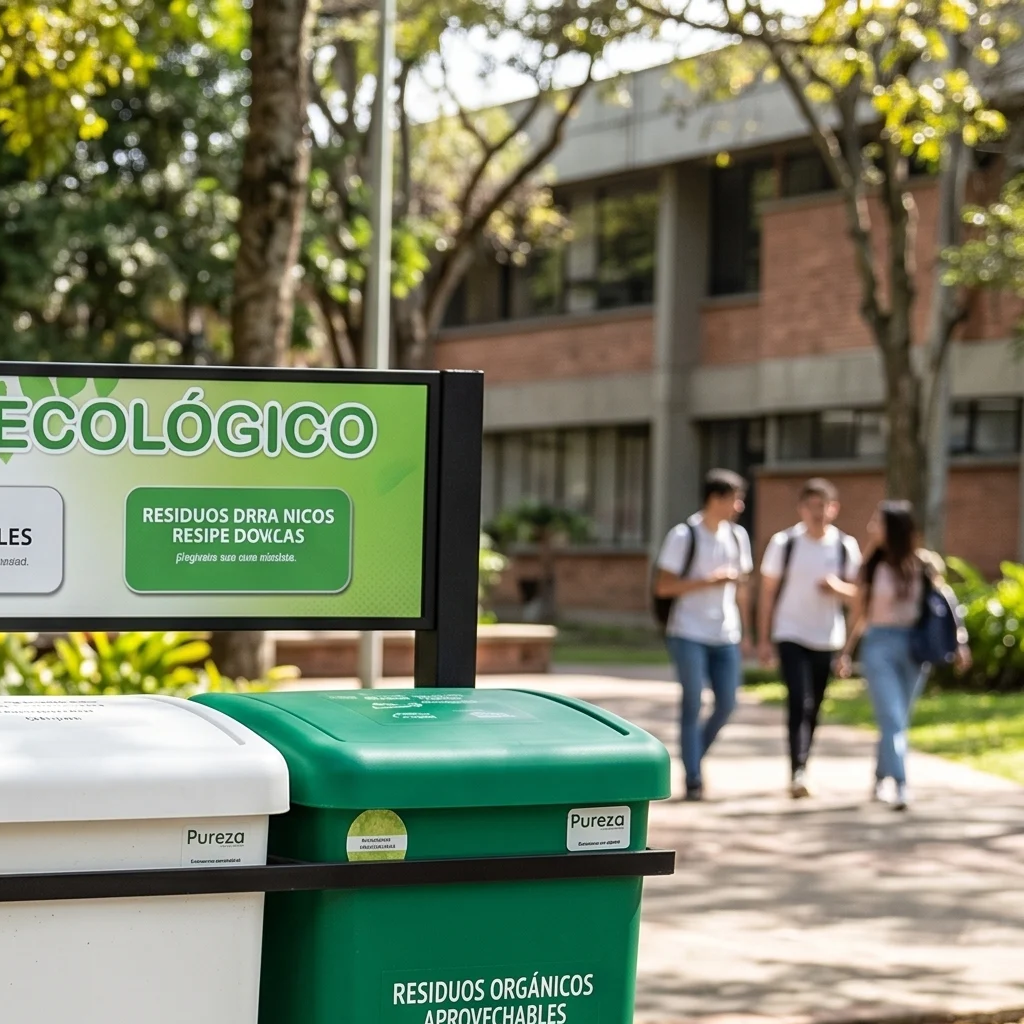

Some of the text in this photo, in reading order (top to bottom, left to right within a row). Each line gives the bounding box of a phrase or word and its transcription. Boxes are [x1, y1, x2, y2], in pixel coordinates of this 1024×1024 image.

[142, 507, 335, 524] RESIDUOS DRRA NICOS
[172, 528, 230, 543] RESIPE
[571, 814, 624, 828] Pureza
[187, 829, 245, 844] Pureza
[393, 971, 594, 1005] RESIDUOS ORGÁNICOS
